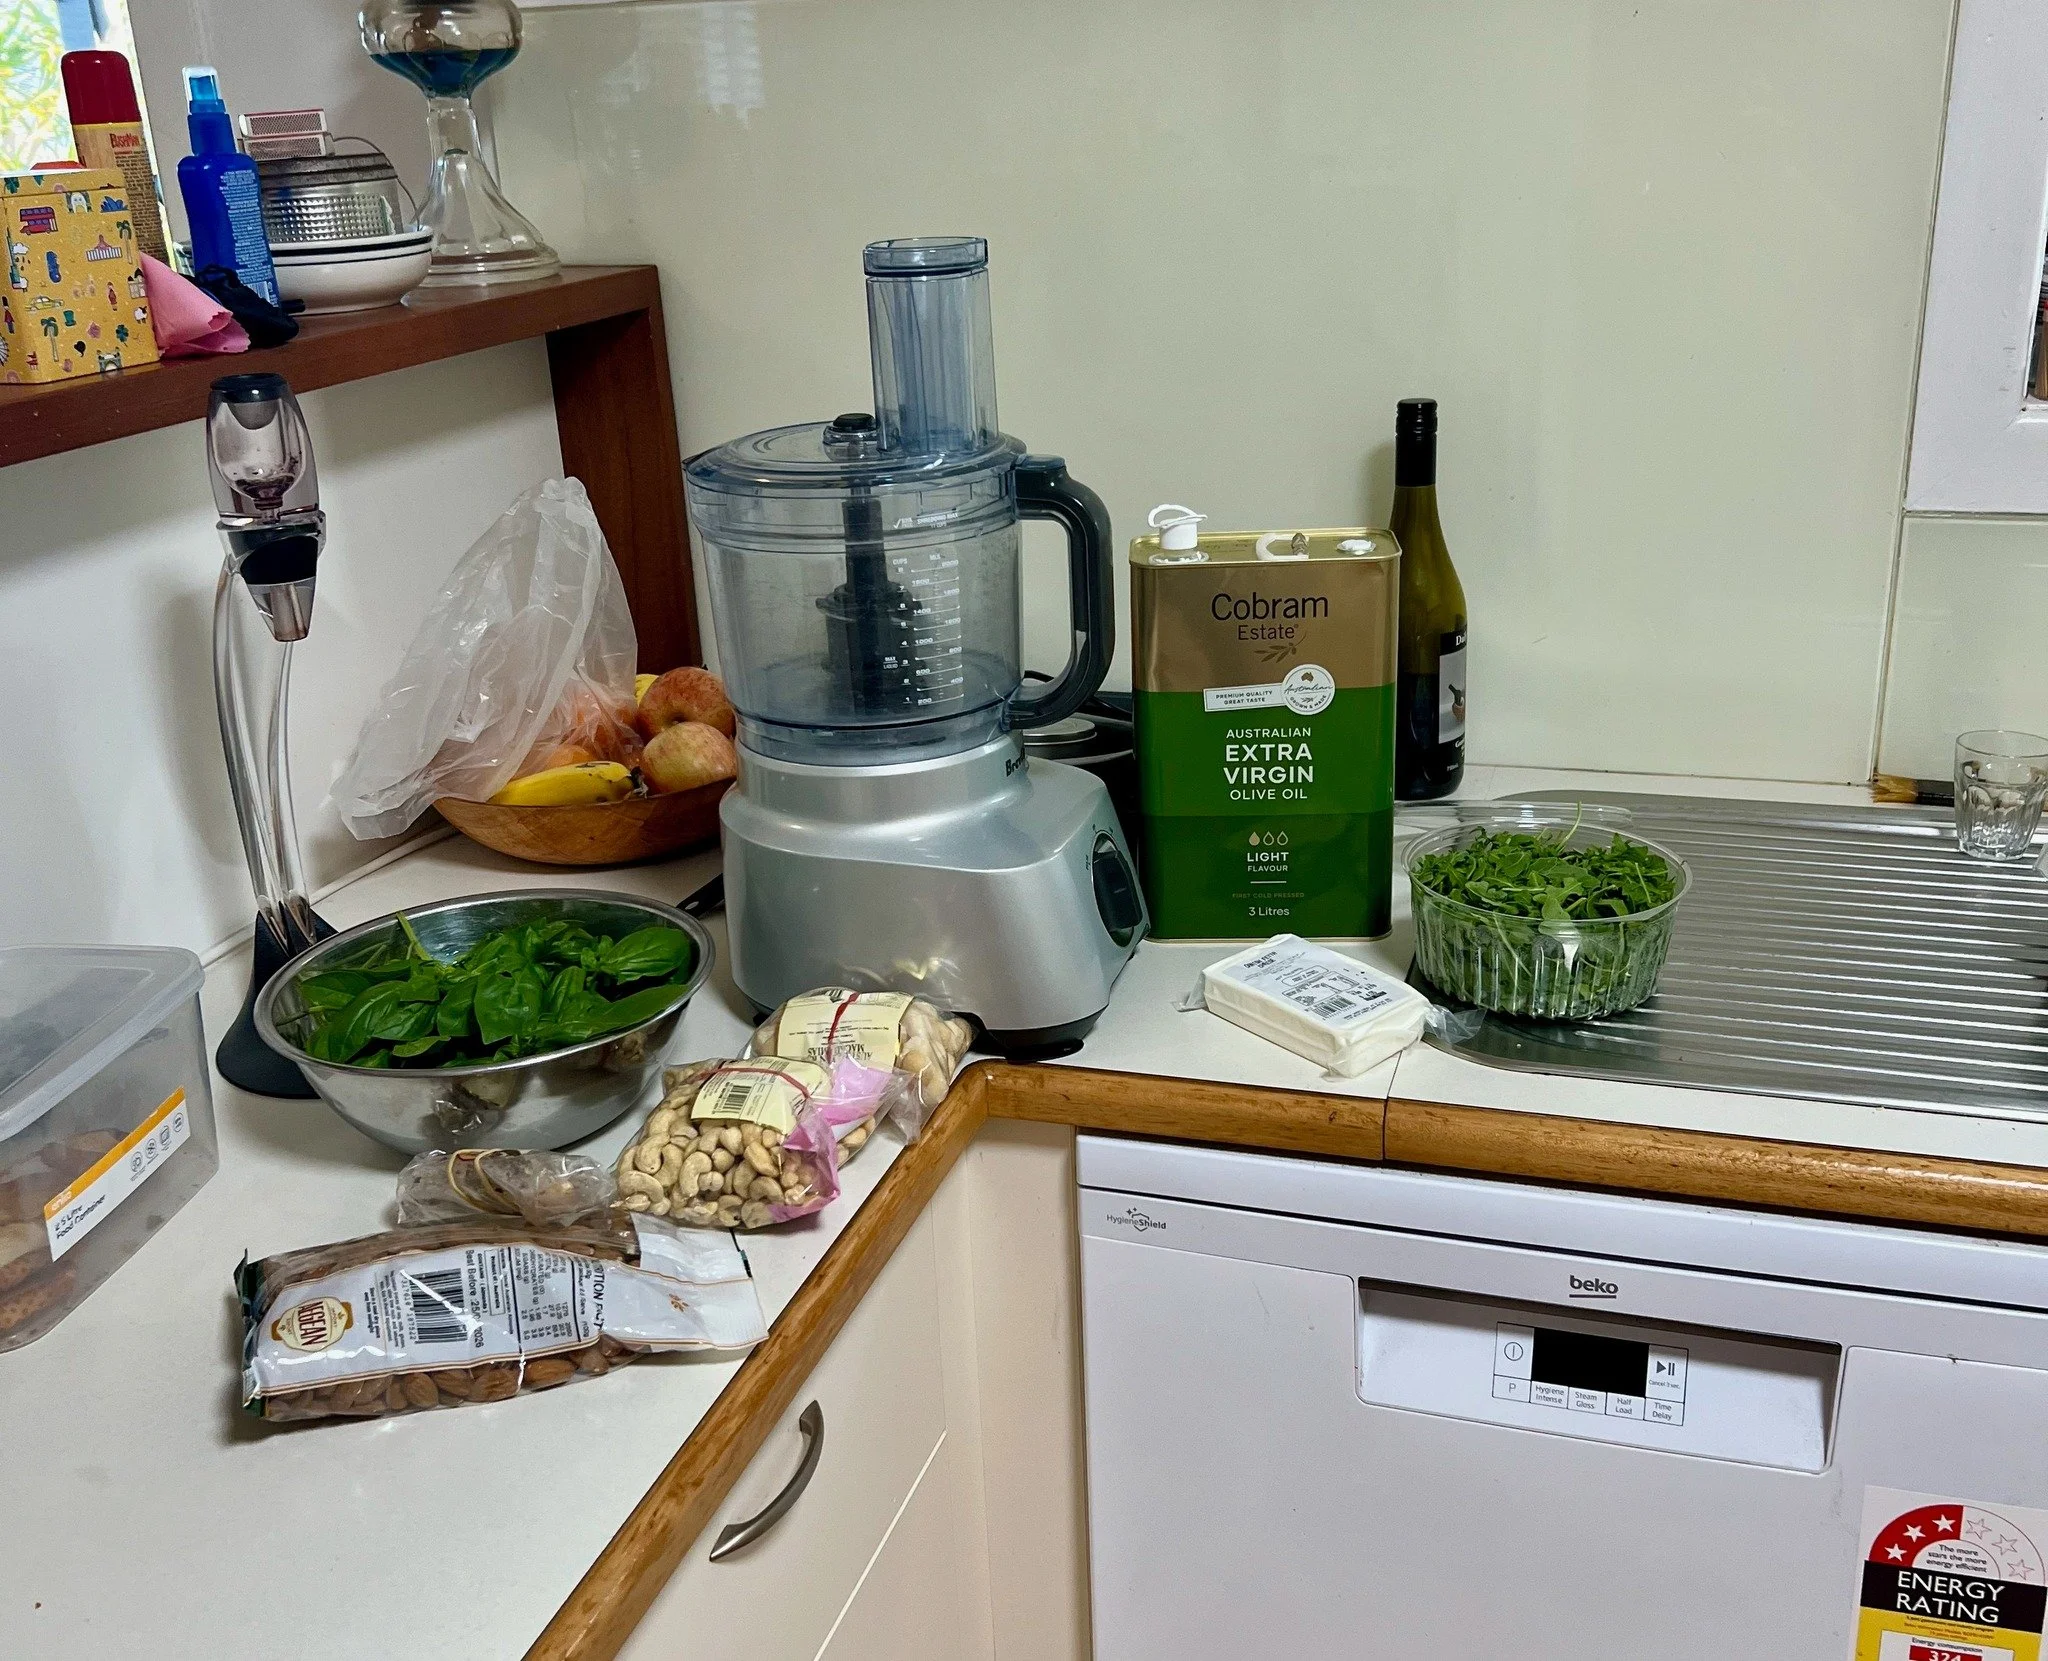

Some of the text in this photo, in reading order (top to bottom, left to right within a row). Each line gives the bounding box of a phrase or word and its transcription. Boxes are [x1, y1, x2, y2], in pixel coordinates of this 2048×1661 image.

[1212, 592, 1328, 620] Cobram
[1246, 690, 1273, 698] QUALITY
[1289, 696, 1308, 709] GROWN
[1226, 727, 1311, 738] AUSTRALIAN
[1226, 743, 1312, 762] EXTRA
[1223, 766, 1314, 784] VIRGIN
[1230, 788, 1308, 800] OLIVE OIL
[1247, 852, 1289, 862] LIGHT
[1249, 906, 1290, 916] 3 Litres
[56, 1194, 106, 1239] Food Container
[1106, 1214, 1166, 1230] HygieneShield
[466, 1250, 475, 1266] Best
[468, 1269, 478, 1296] Before
[1570, 1275, 1618, 1294] beko
[298, 1301, 328, 1346] AEGEAN
[1508, 1382, 1516, 1394] P
[1648, 1379, 1665, 1388] Cancel
[1536, 1385, 1564, 1397] Hygiene
[1574, 1392, 1598, 1401] Steam
[1536, 1394, 1563, 1404] Intense
[1576, 1400, 1595, 1410] Gloss
[1616, 1397, 1632, 1406] Half
[1615, 1406, 1633, 1414] Load
[1654, 1402, 1672, 1411] Time
[1652, 1410, 1672, 1421] Delay
[1938, 1544, 1978, 1556] The more
[1928, 1552, 1948, 1560] stars
[1950, 1554, 1962, 1562] the
[1926, 1560, 1987, 1573] energy efficient
[1898, 1570, 2005, 1601] ENERGY
[1896, 1593, 1999, 1624] RATING
[1912, 1637, 1936, 1646] Energy
